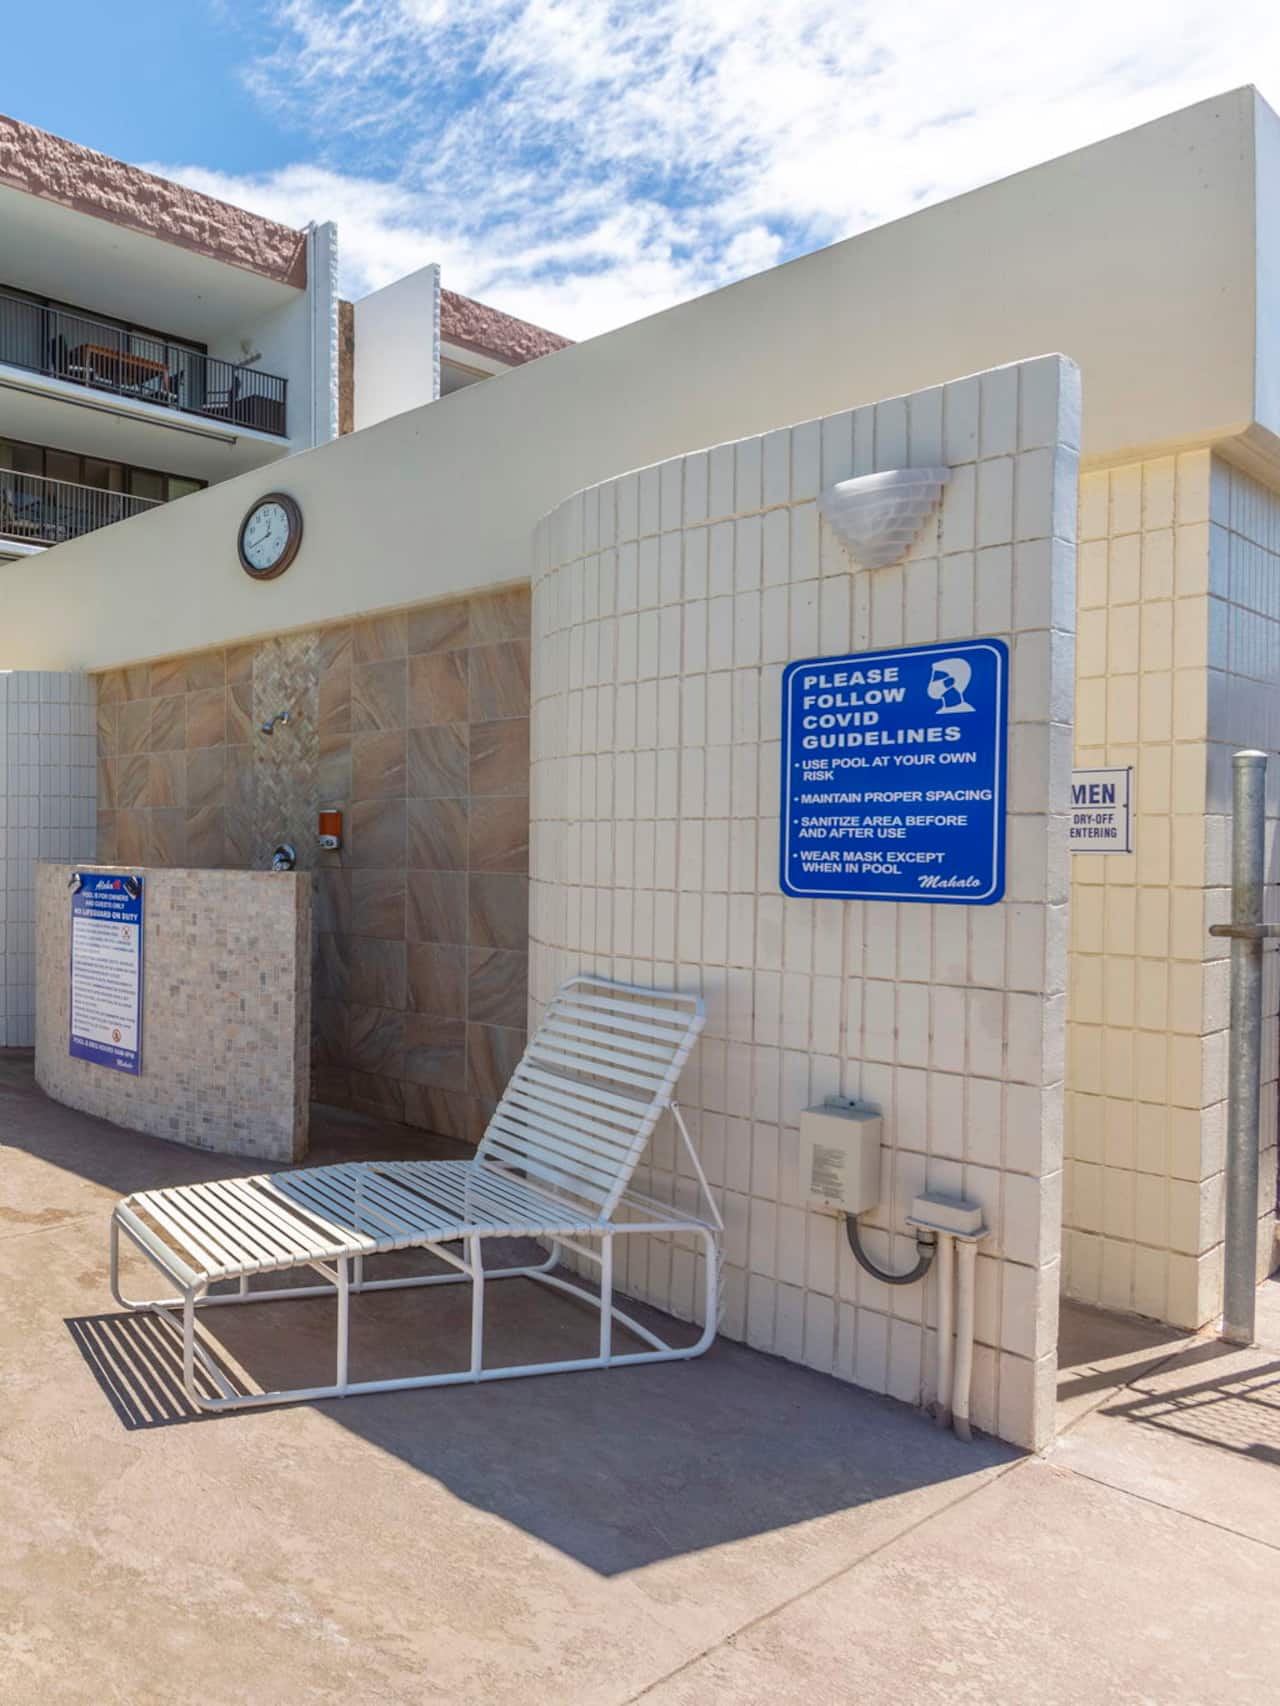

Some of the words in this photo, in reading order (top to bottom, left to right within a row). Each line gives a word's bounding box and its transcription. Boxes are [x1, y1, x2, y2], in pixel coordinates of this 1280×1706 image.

[804, 667, 899, 690] PLEASE
[803, 688, 906, 710] FOLLOW
[803, 711, 879, 729] COVID
[802, 726, 961, 749] GUIDELINES
[802, 759, 828, 770] USE
[832, 757, 869, 769] POOL
[873, 756, 889, 767] AT
[894, 754, 935, 766] YOUR
[939, 752, 976, 764] OWN
[803, 771, 834, 781] RISK
[801, 793, 861, 804] MAINTAIN
[864, 792, 922, 803] PROPER
[926, 790, 992, 801] SPACING
[801, 817, 860, 826] SANITIZE
[863, 816, 901, 826] AREA
[905, 816, 968, 826] BEFORE
[1074, 814, 1114, 824] DRY-OFF
[799, 828, 827, 838] AND
[829, 828, 874, 838] AFTER
[877, 828, 906, 838] USE
[1070, 828, 1117, 838] ENTERING
[800, 851, 840, 861] WEAR
[843, 852, 883, 861] MASK
[887, 852, 945, 863] EXCEPT
[803, 863, 842, 873] WHEN
[845, 863, 858, 872] IN
[862, 864, 902, 874] POOL
[918, 875, 981, 889] Mahalo
[122, 912, 137, 920] DUTY
